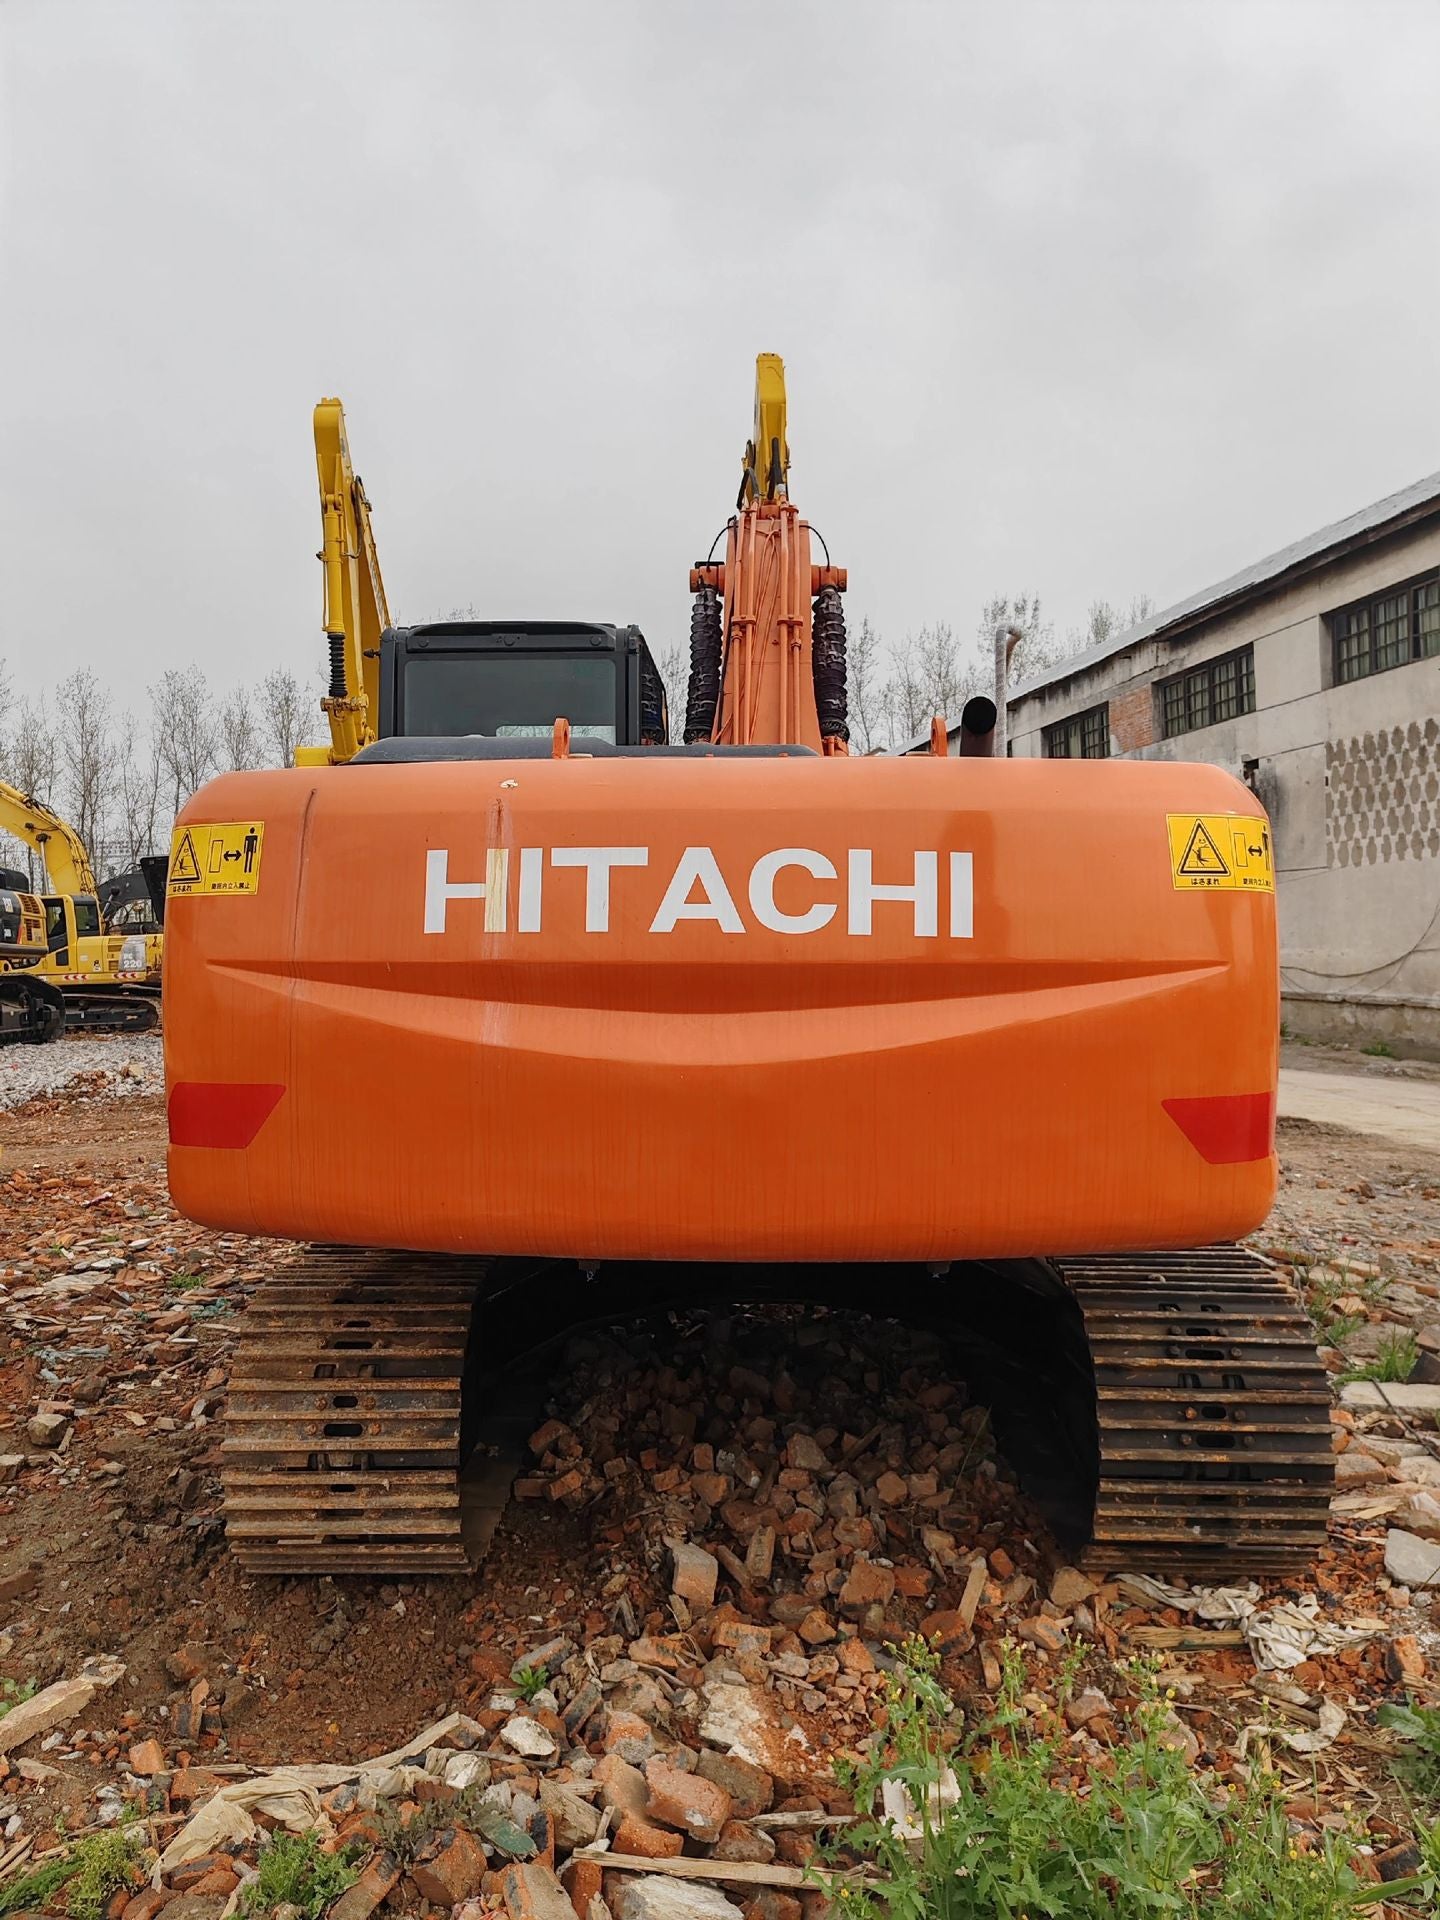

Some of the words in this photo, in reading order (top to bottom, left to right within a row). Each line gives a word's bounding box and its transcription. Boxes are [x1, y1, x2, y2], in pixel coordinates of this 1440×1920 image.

[1191, 878, 1220, 886] はさまれ
[424, 847, 973, 938] HITACHI
[123, 960, 142, 969] 220
